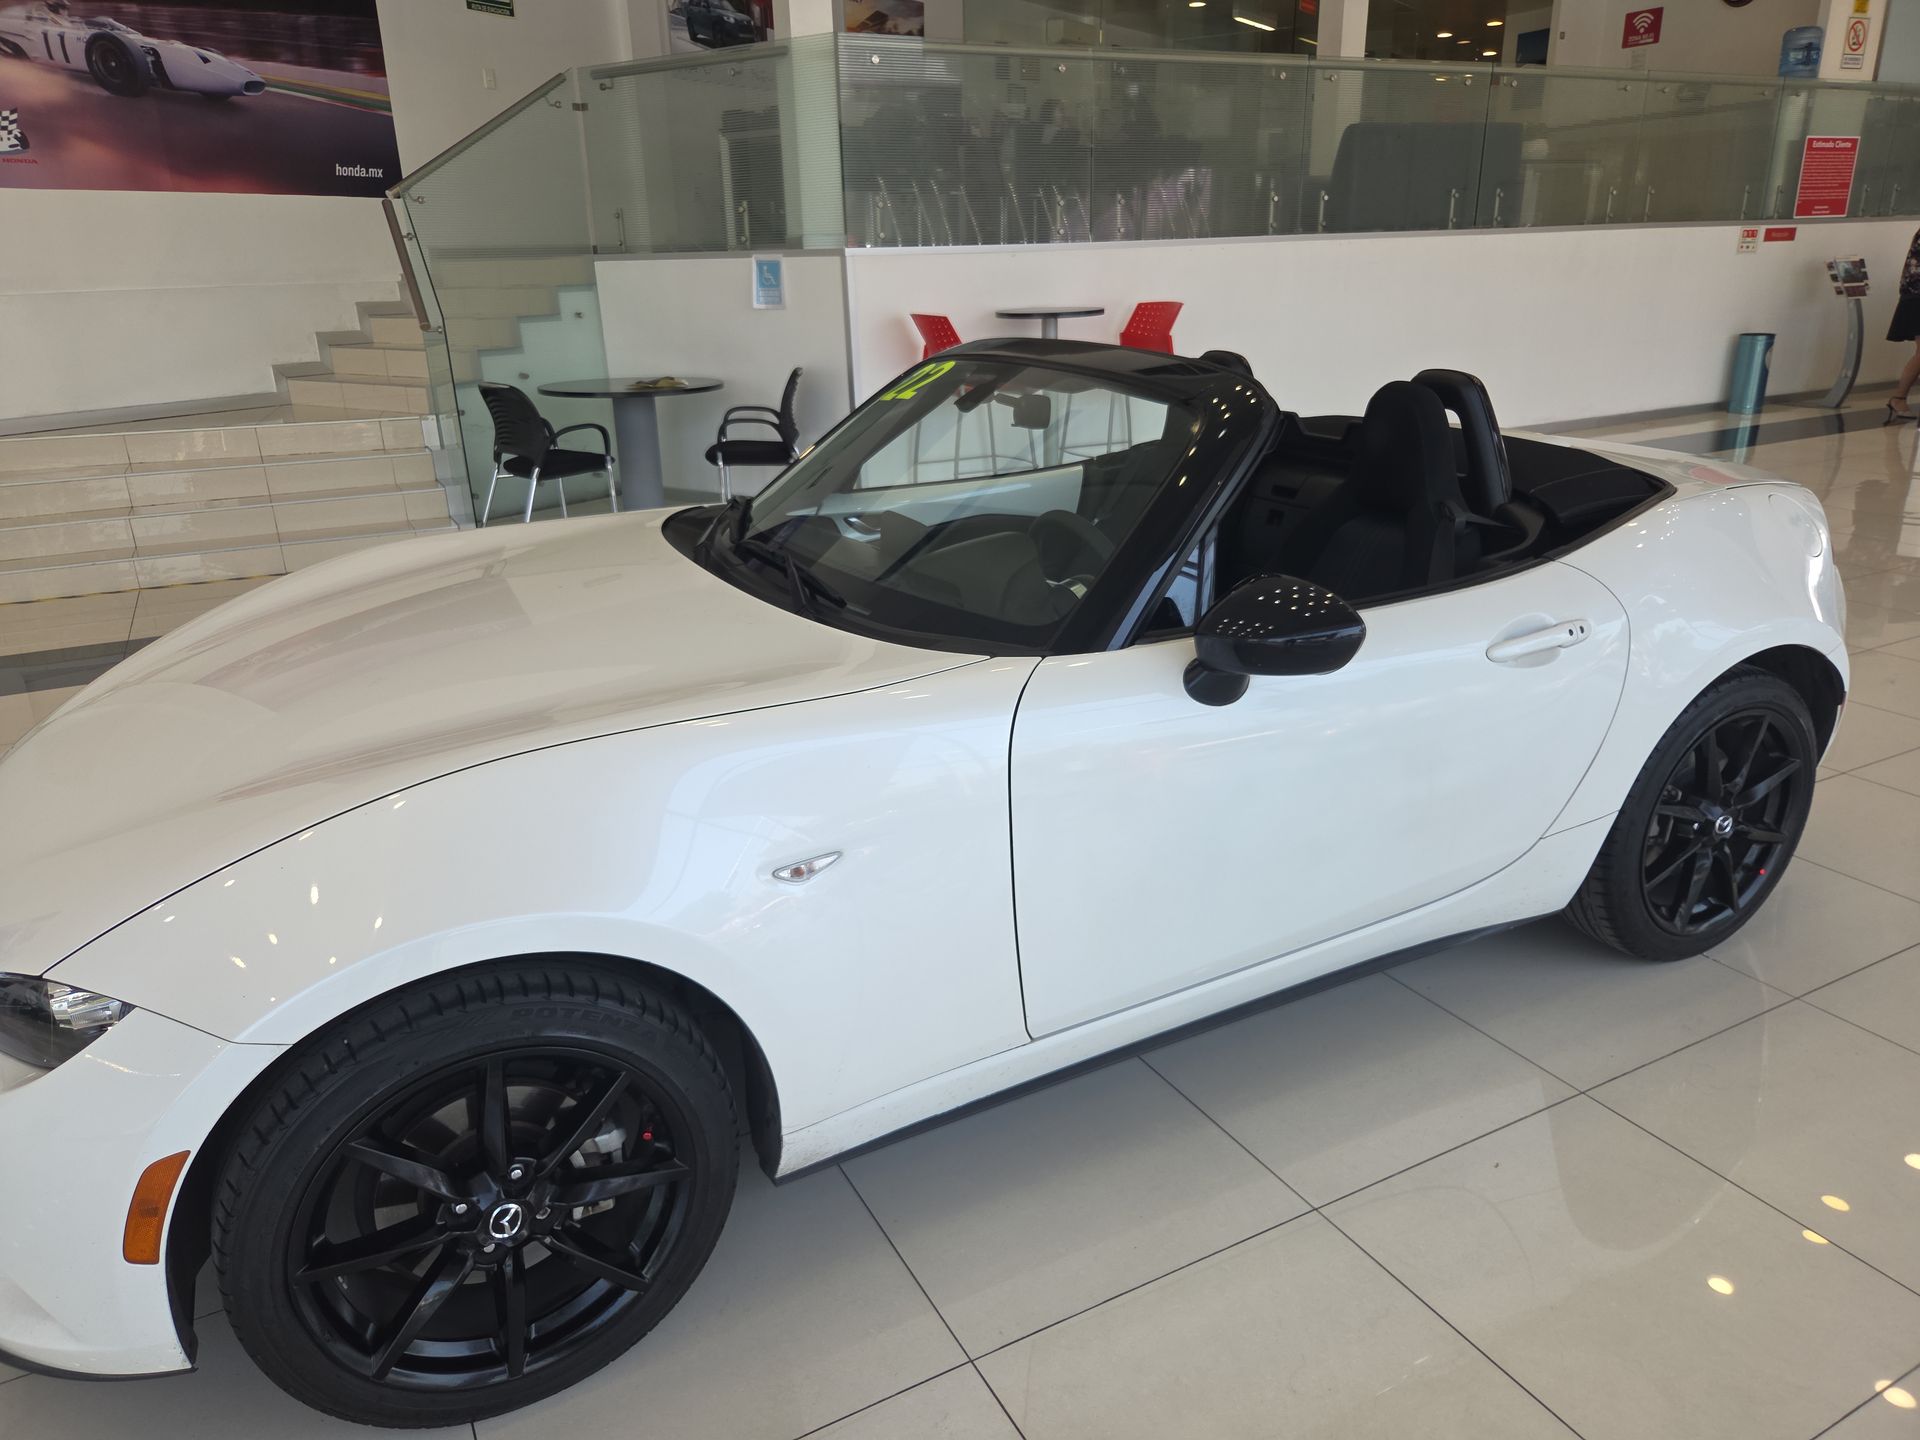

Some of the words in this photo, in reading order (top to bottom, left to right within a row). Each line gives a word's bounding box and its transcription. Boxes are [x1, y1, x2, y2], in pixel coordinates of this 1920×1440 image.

[41, 31, 71, 64] 11
[335, 163, 383, 178] honda.mx
[880, 360, 957, 401] 22
